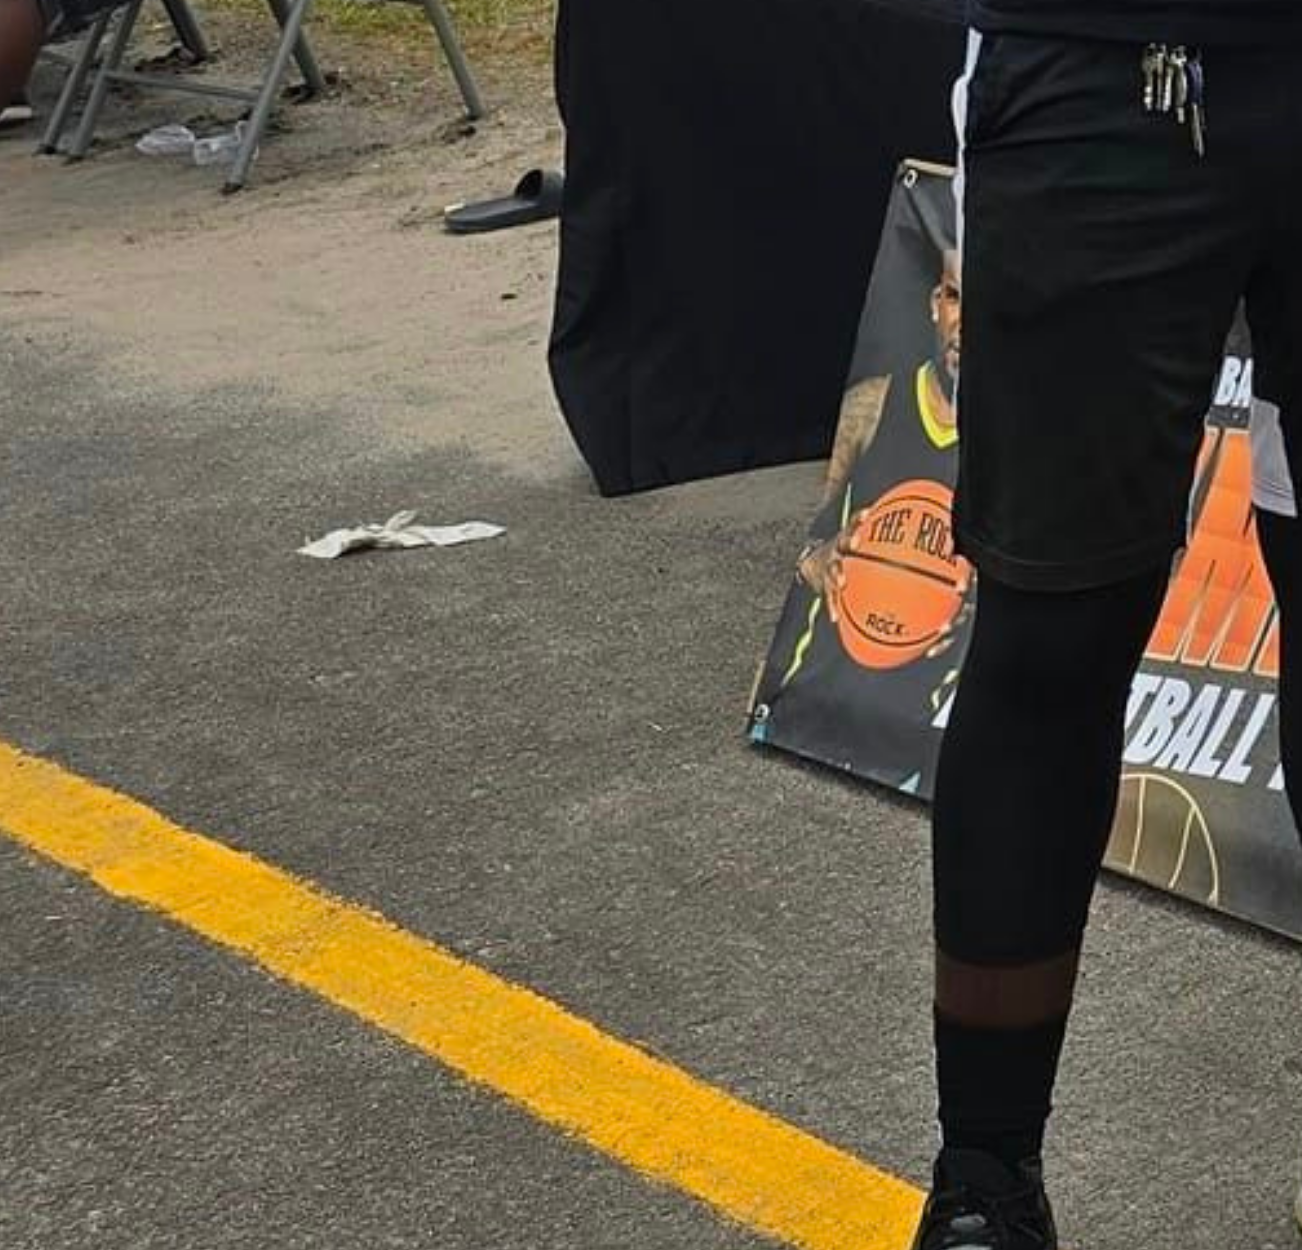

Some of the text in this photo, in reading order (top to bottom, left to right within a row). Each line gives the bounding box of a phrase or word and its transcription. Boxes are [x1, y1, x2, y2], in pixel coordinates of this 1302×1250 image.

[868, 508, 957, 568] THE ROC
[865, 612, 905, 636] ROCK
